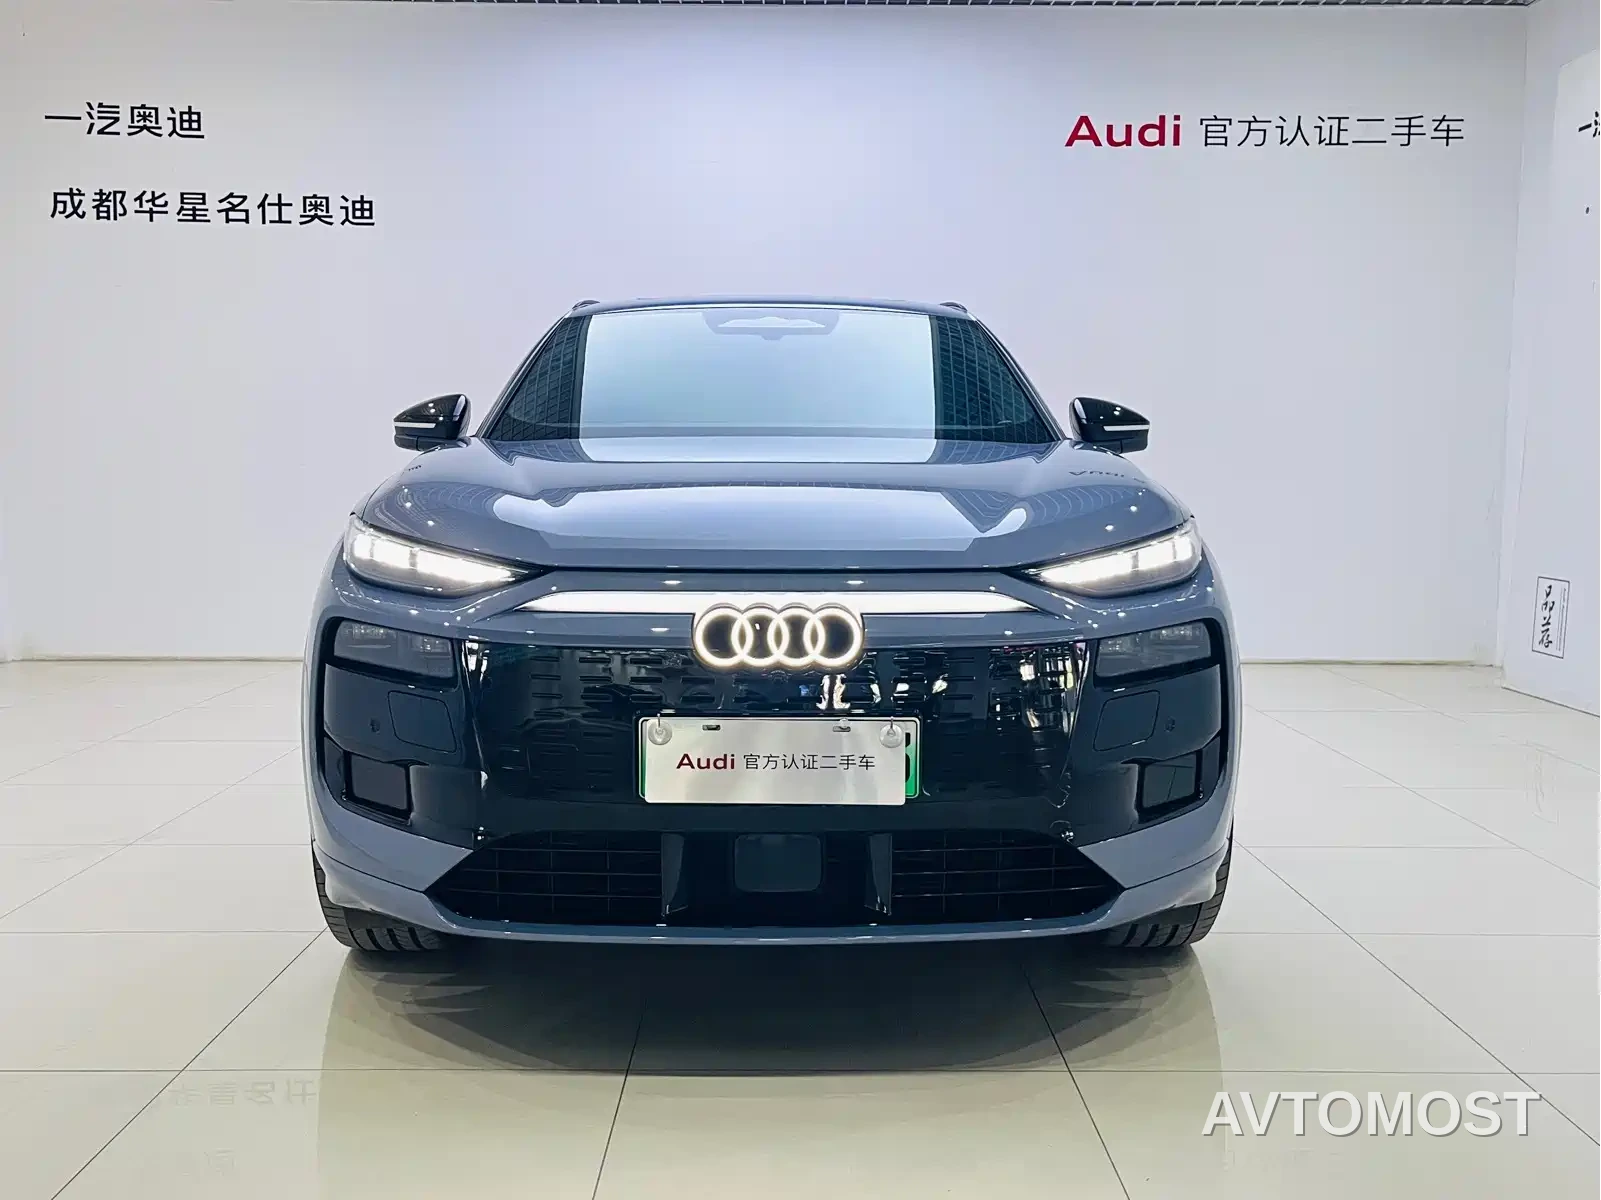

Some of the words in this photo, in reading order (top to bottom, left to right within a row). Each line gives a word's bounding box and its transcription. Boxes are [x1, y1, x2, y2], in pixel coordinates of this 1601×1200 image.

[44, 101, 205, 140] 一汽奥迪
[1064, 114, 1181, 148] Audi
[1199, 114, 1465, 148] 官方认证二手车
[49, 186, 376, 227] 成都华星名仕奥迪
[675, 753, 736, 771] Audi
[743, 753, 876, 771] 官方认证二手车
